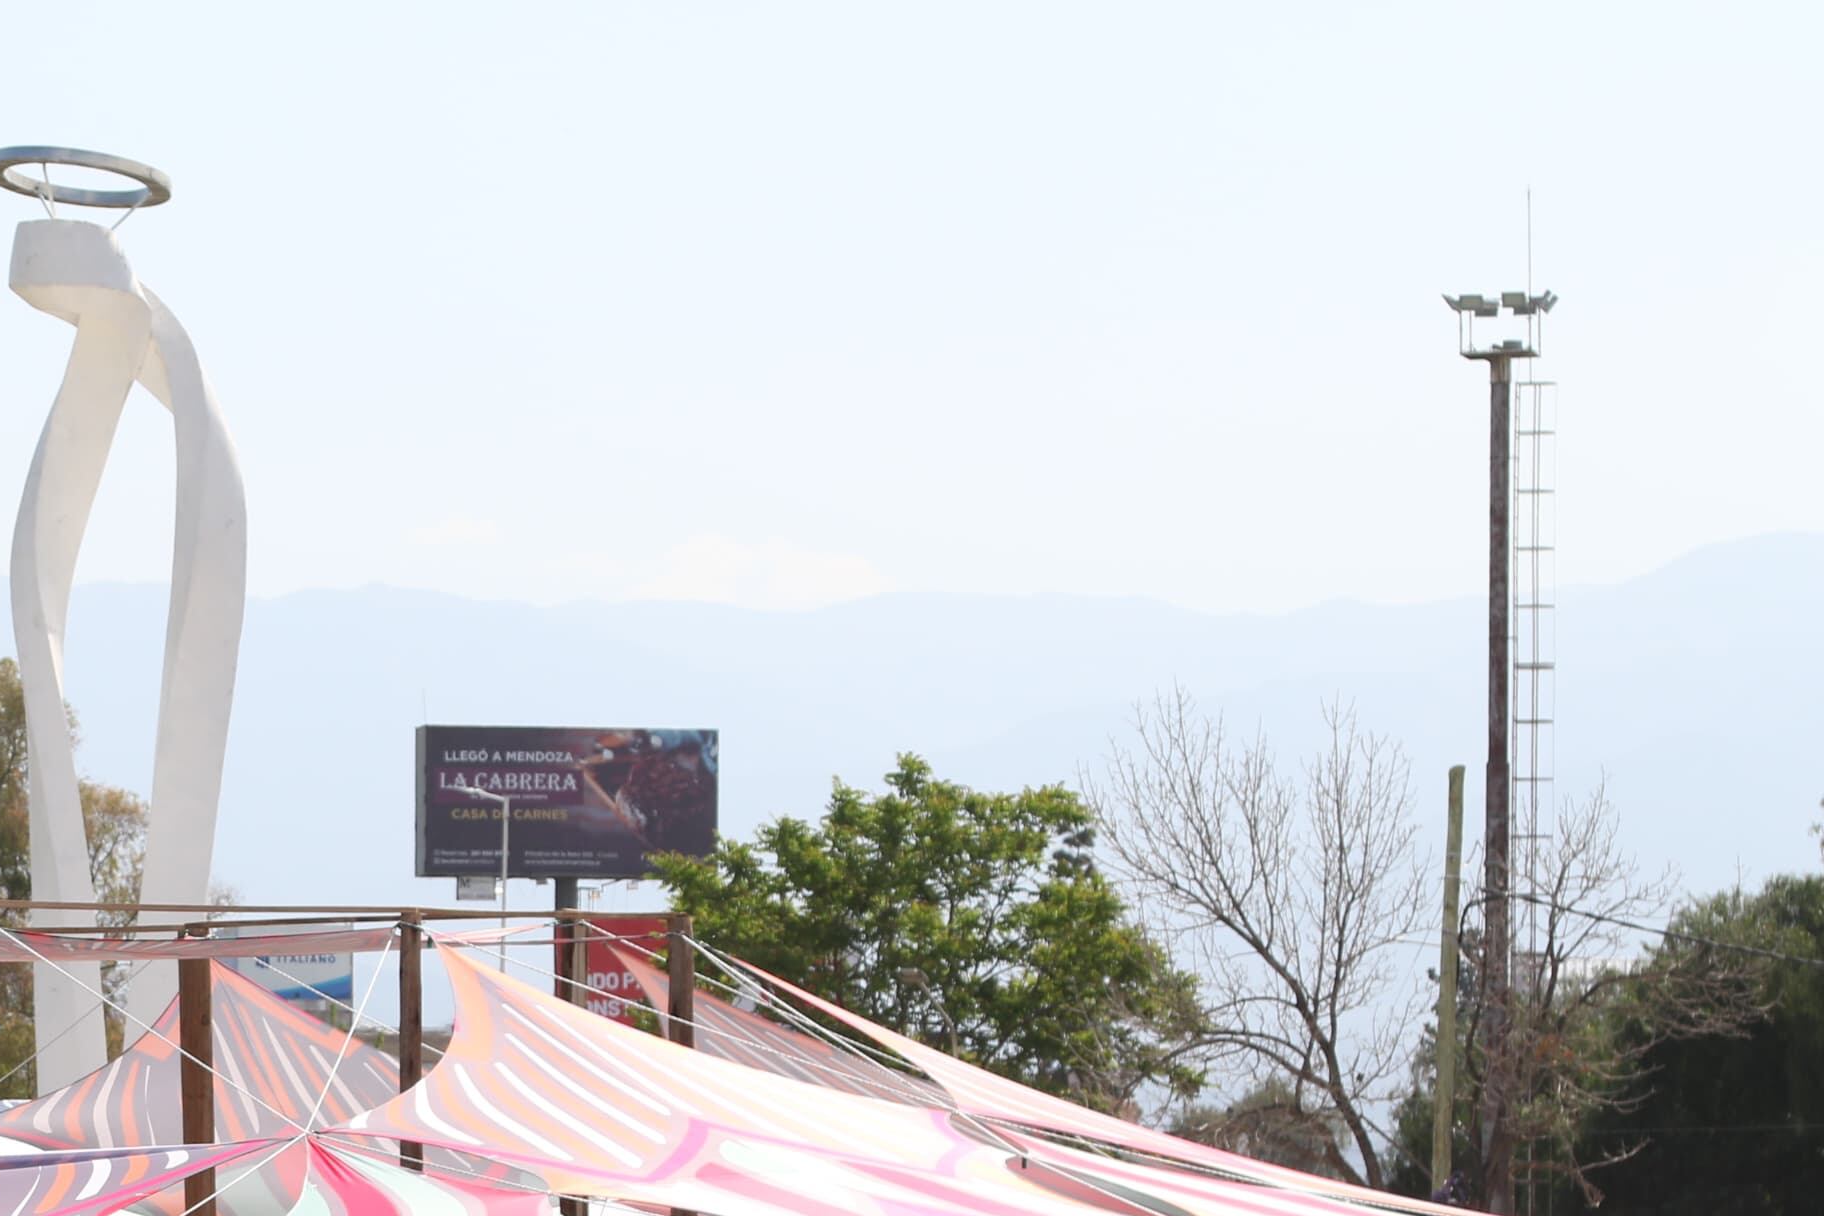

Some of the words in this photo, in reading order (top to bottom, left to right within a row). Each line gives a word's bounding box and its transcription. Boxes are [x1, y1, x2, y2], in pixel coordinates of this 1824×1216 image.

[444, 747, 489, 763] LLEGÓ
[491, 751, 502, 763] A
[505, 751, 574, 763] MENDOZA
[439, 771, 468, 790] LA
[474, 771, 578, 792] CABRERA
[451, 808, 489, 821] CASA
[514, 808, 569, 821] CARNES
